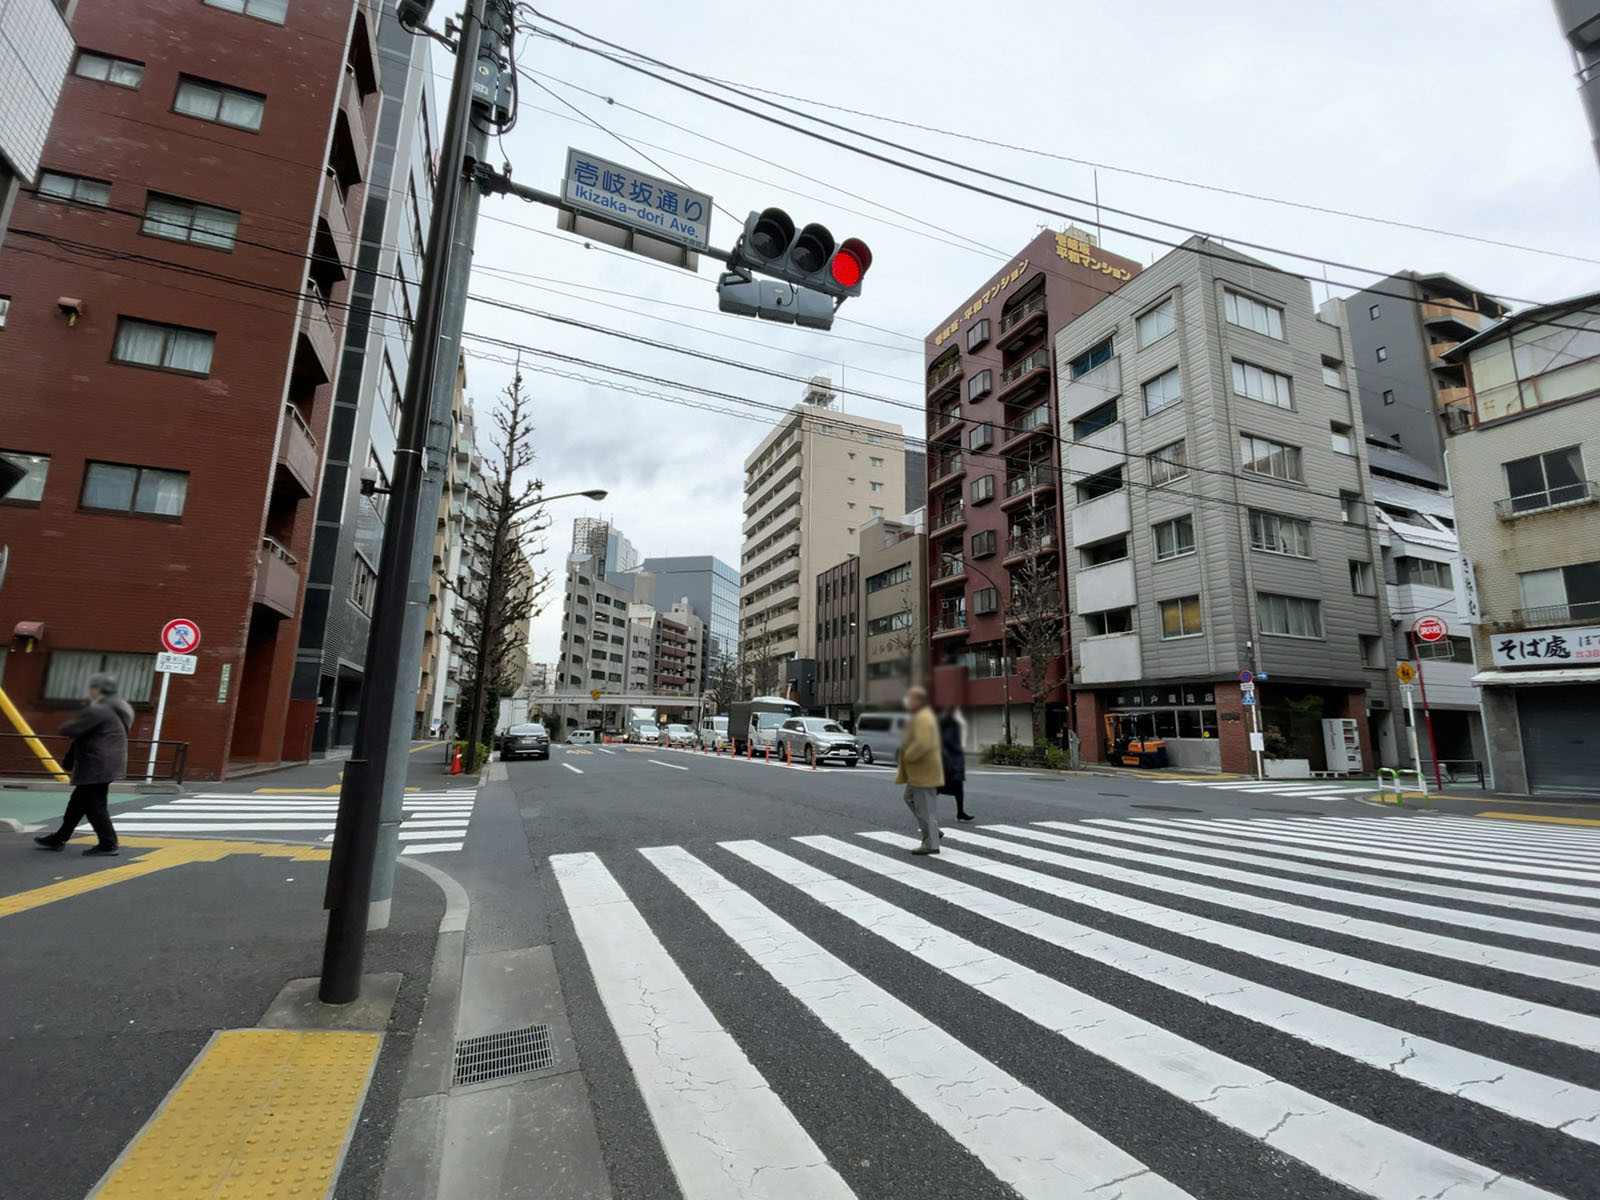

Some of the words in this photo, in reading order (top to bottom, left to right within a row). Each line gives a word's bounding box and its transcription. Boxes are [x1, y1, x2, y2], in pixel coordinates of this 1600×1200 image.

[574, 160, 703, 222] 壱岐坂通り
[575, 184, 664, 226] Ikizaka-dori
[670, 217, 699, 239] Ave.
[1056, 245, 1132, 281] 平和マンション
